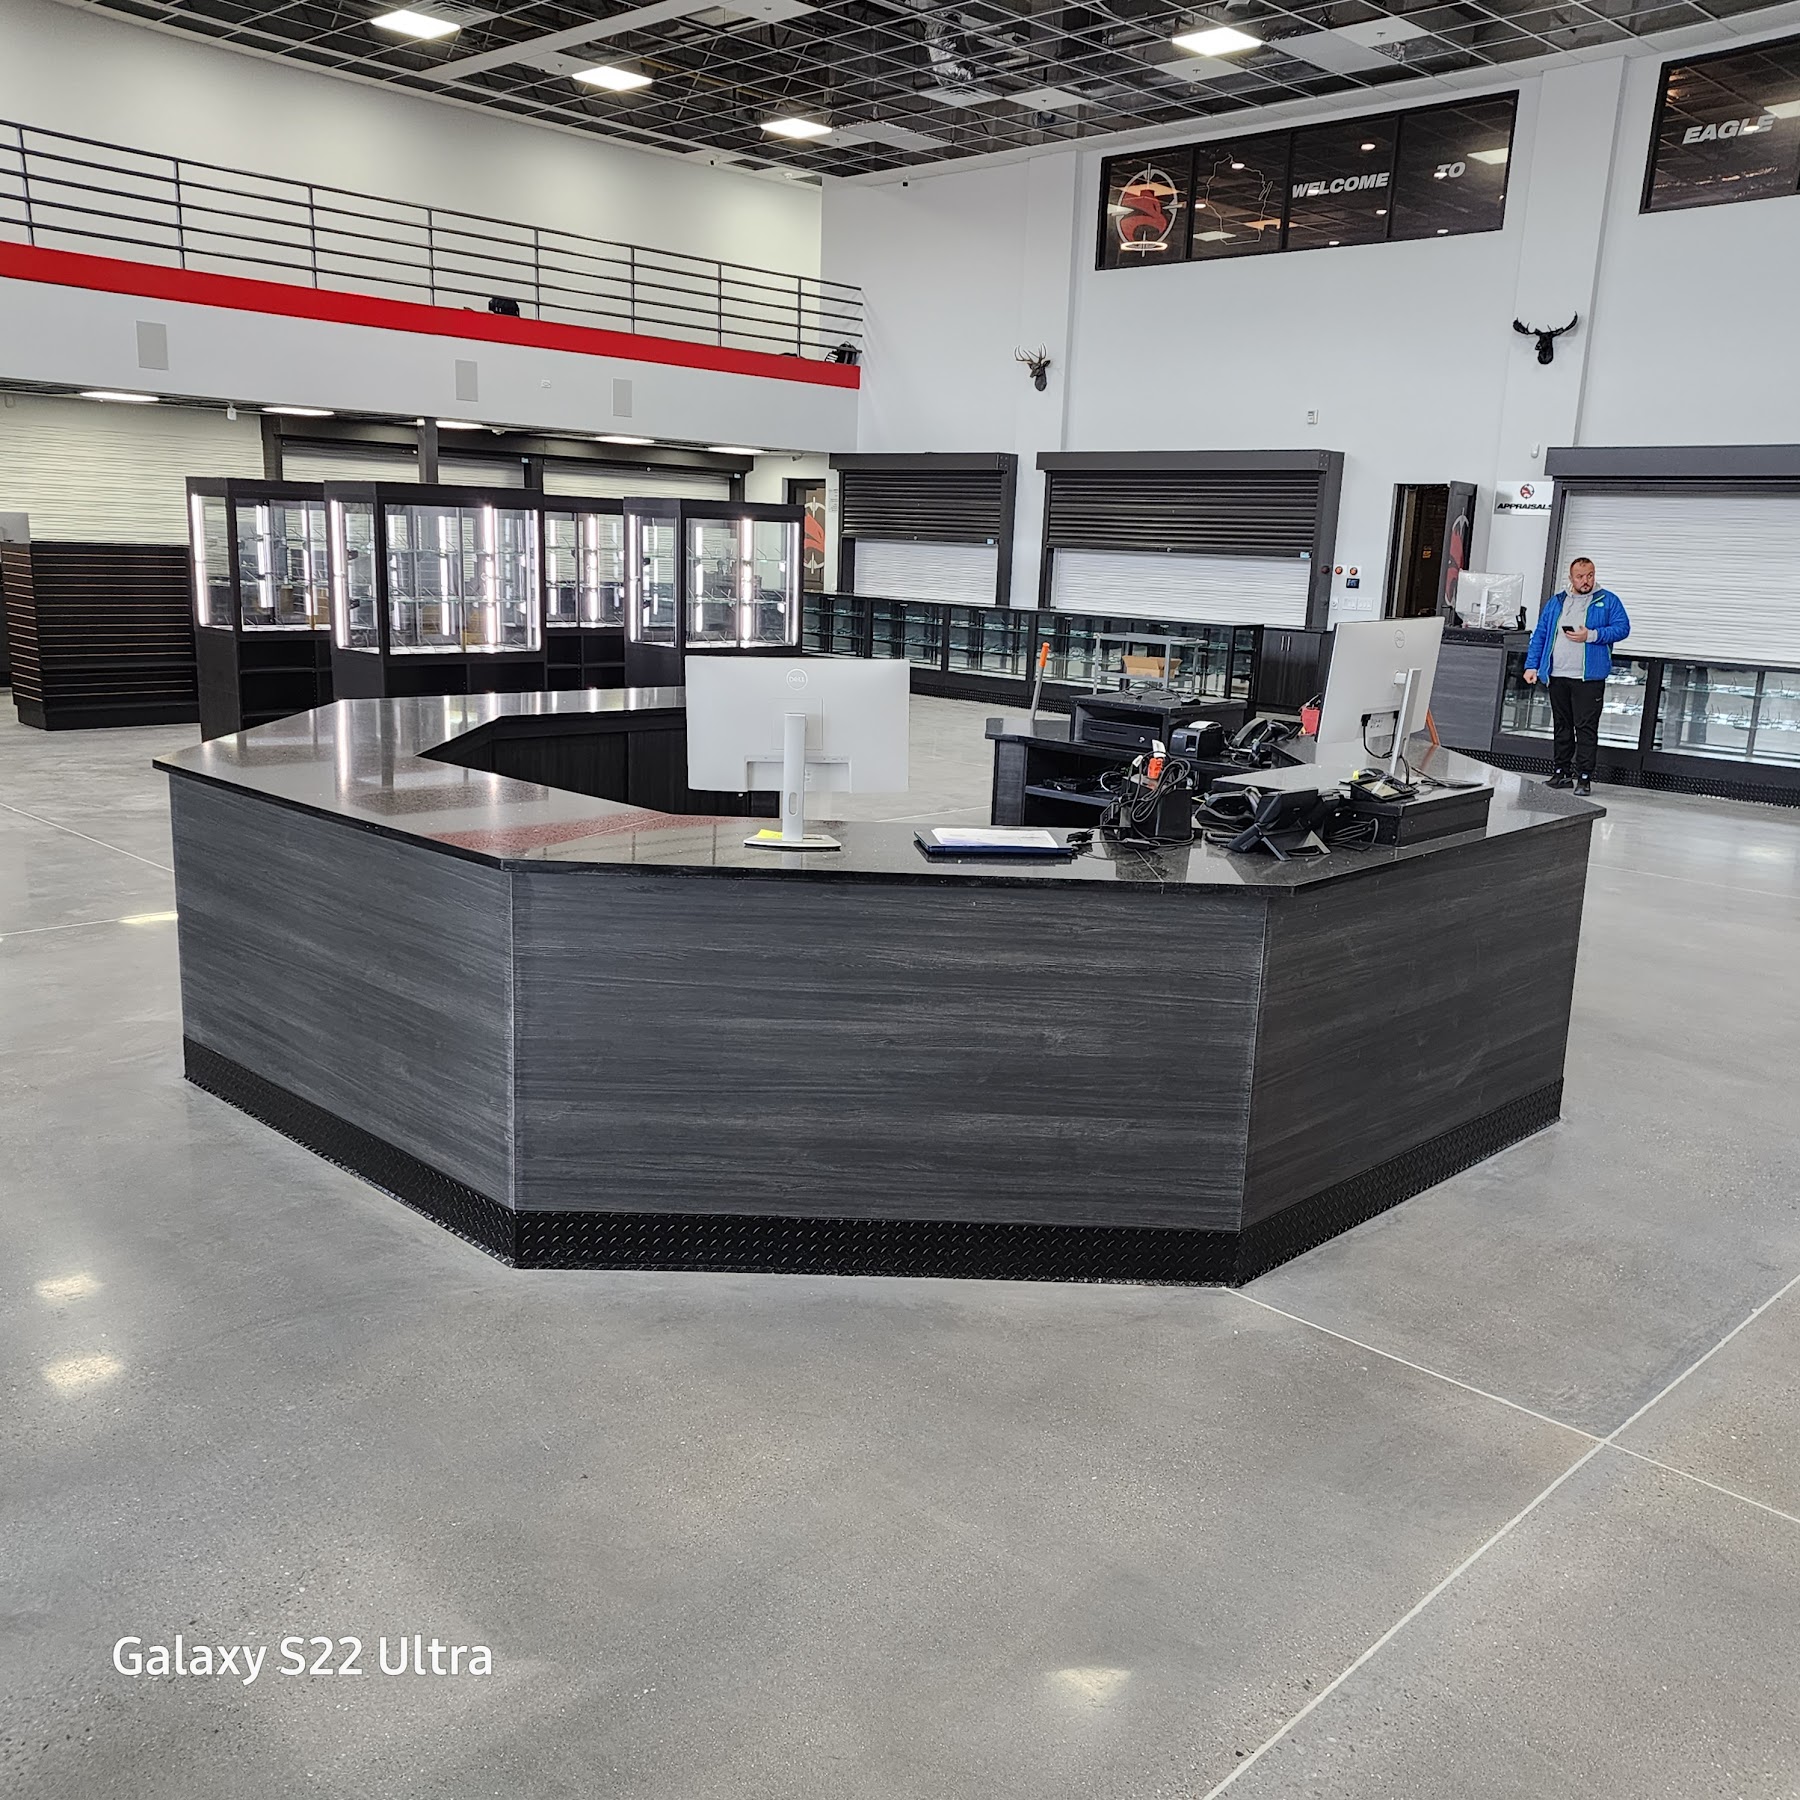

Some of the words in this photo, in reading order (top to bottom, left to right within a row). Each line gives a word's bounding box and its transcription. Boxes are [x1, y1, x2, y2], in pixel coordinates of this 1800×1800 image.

[1292, 172, 1390, 198] WELCOME
[1435, 161, 1466, 179] TO
[1682, 114, 1776, 144] EAGLE
